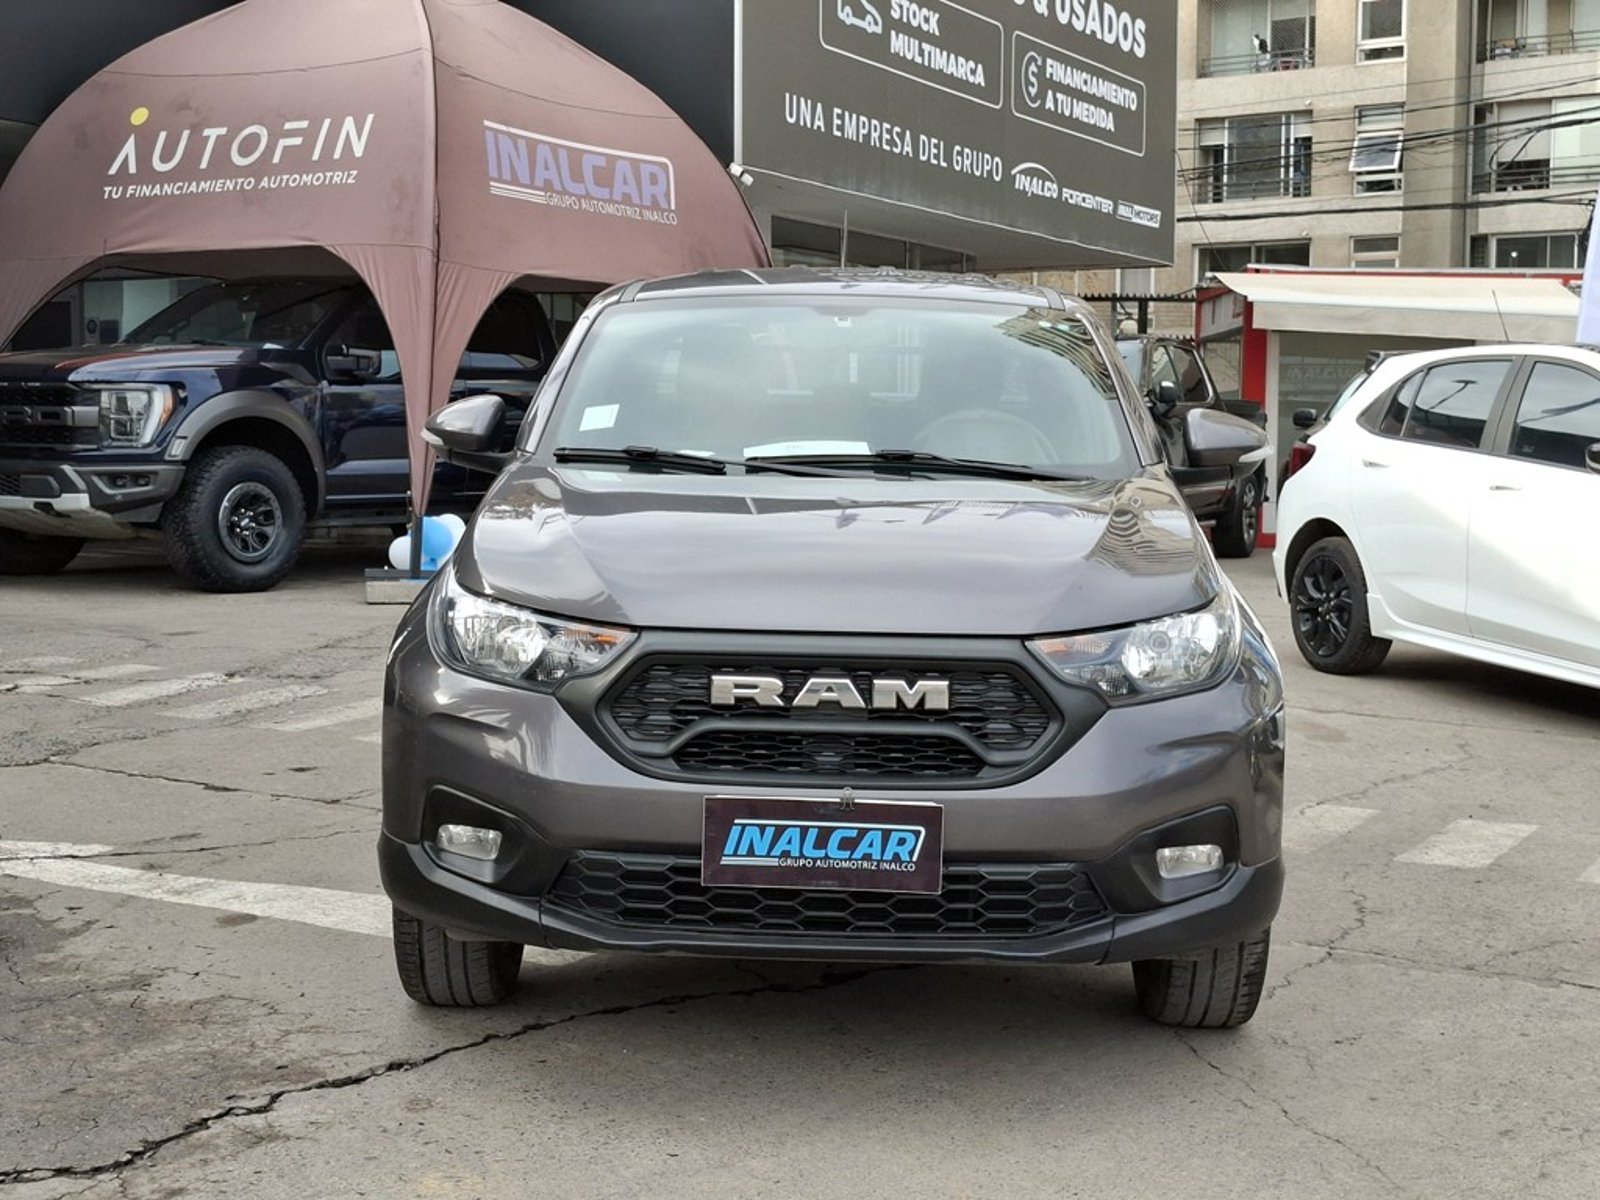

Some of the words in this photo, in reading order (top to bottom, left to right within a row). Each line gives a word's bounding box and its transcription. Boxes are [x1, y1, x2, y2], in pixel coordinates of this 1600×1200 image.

[890, 0, 940, 36] STOCK
[1055, 0, 1146, 59] USADOS
[890, 29, 985, 87] MULTIMARCA
[1045, 57, 1138, 112] FINANCIAMIENTO
[1044, 89, 1055, 112] A
[1055, 92, 1071, 117] TU
[1072, 98, 1115, 132] MEDIDA
[108, 107, 375, 176] AUTOFIN
[785, 92, 825, 132] UNA
[832, 107, 914, 158] EMPRESA
[919, 134, 948, 168] DEL
[952, 145, 1003, 182] GRUPO
[103, 186, 122, 200] TU
[126, 177, 256, 198] FINANCIAMIENTO
[258, 170, 359, 190] AUTOMOTRIZ
[484, 128, 670, 209] INALCAR
[1014, 172, 1059, 199] INALCO
[545, 191, 580, 210] GRUPO
[580, 198, 642, 220] AUTOMOTRIZ
[642, 211, 678, 226] INALCO
[1061, 187, 1114, 215] FORCENTER
[711, 675, 950, 710] RAM
[723, 825, 917, 861] INALCAR
[779, 857, 814, 868] GRUPO
[815, 859, 879, 870] AUTOMOTRIZ
[879, 862, 916, 872] INALCO
